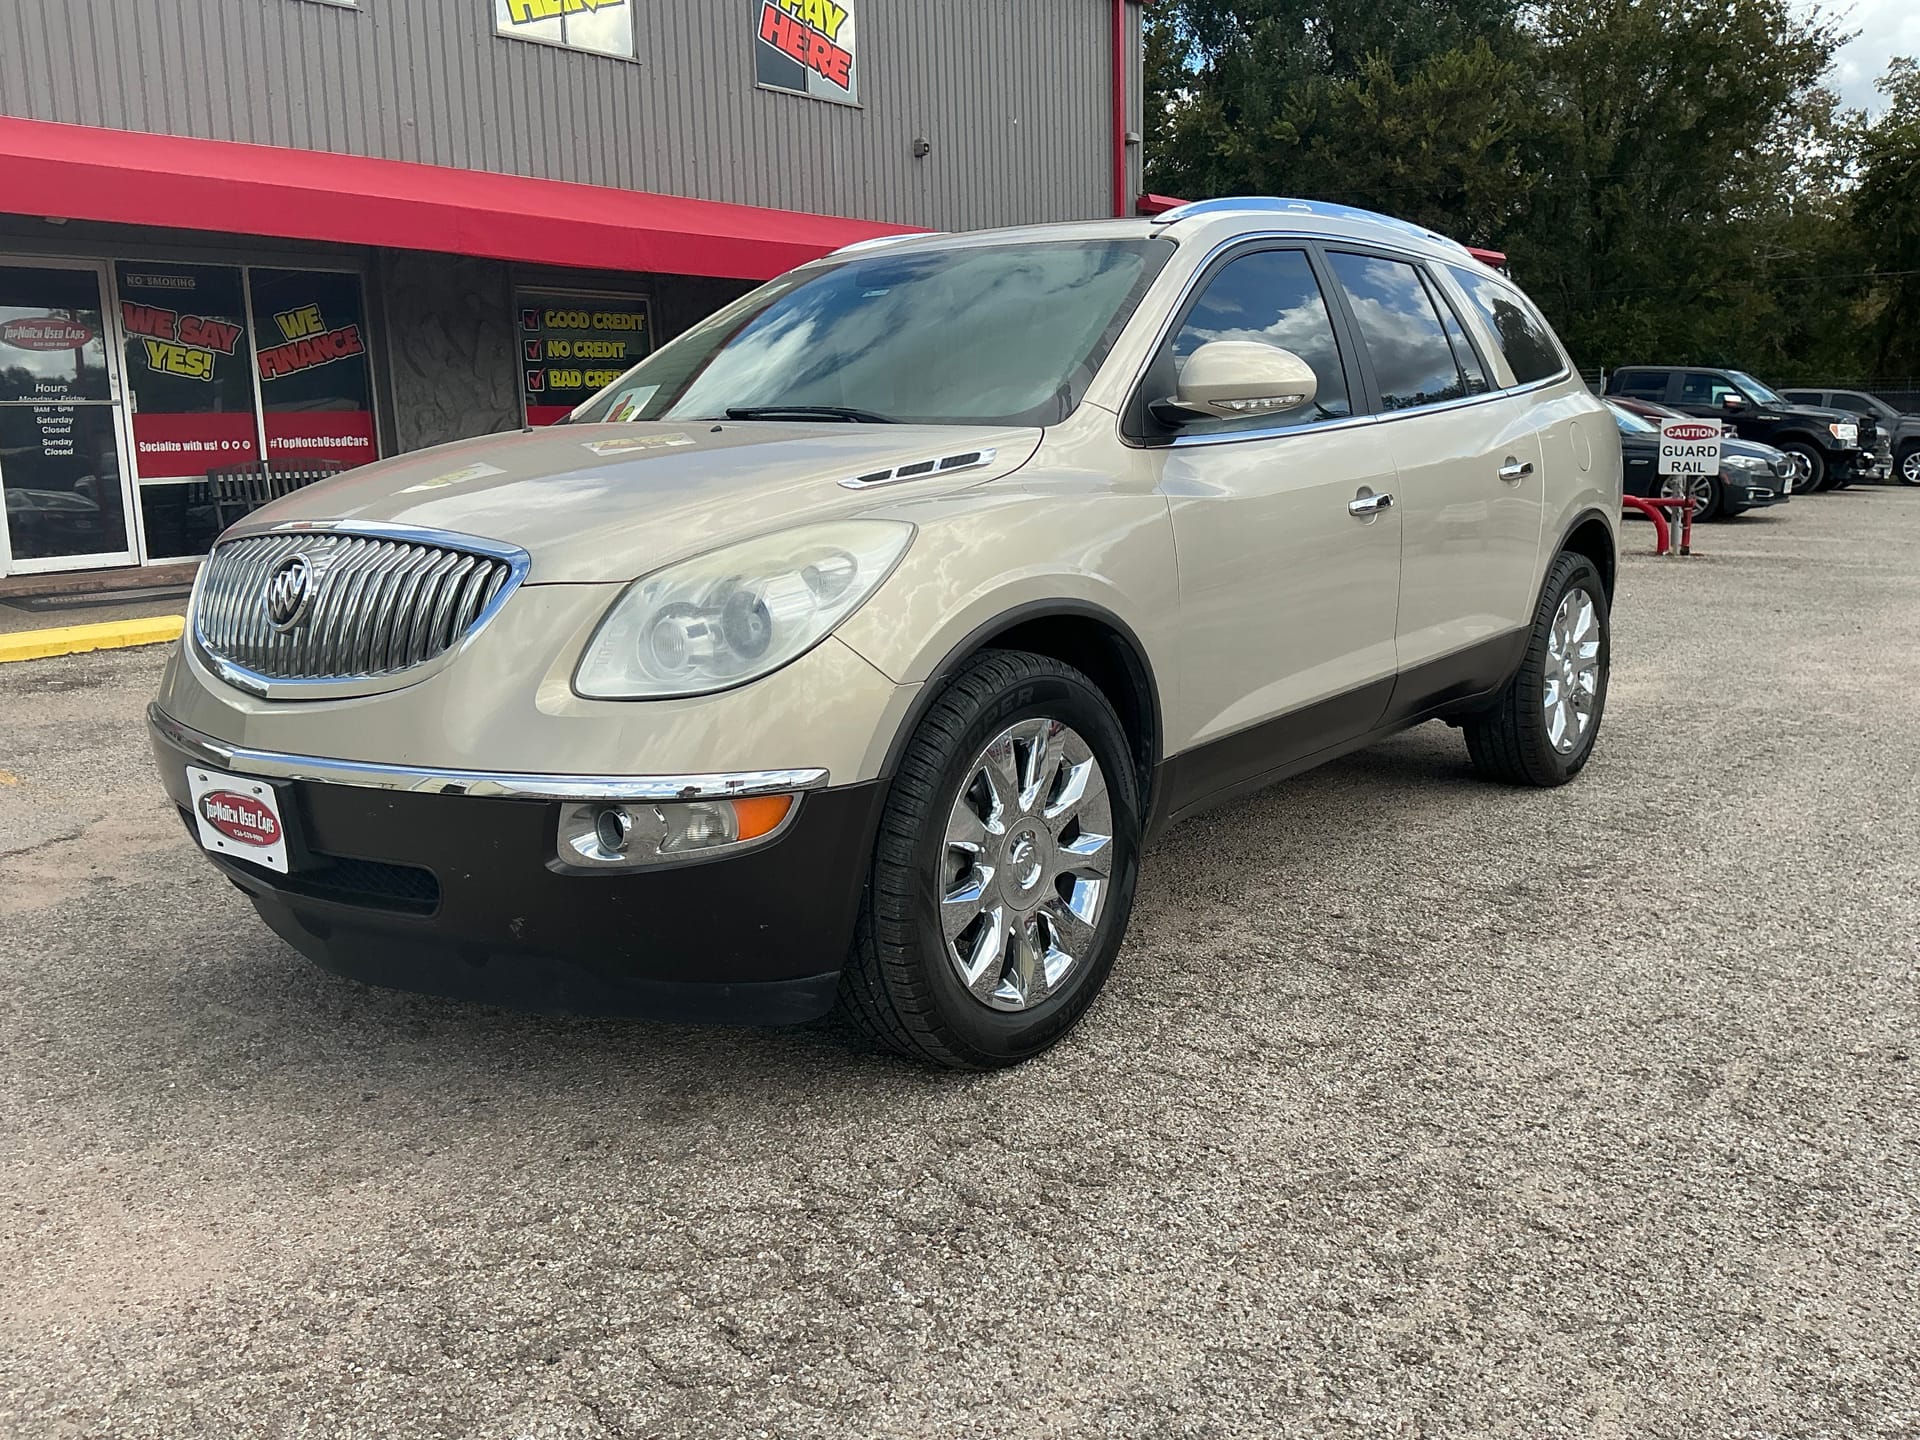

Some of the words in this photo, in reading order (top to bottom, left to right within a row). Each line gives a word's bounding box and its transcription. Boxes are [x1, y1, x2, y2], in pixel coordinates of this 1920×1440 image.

[761, 5, 852, 90] HERE
[126, 275, 143, 285] NO
[147, 277, 196, 288] SMOKING
[276, 305, 324, 339] WE
[544, 309, 590, 329] GOOD
[592, 312, 645, 331] CREDIT
[121, 302, 176, 341] WE
[179, 315, 241, 354] SAY
[257, 325, 364, 379] FINANCE
[547, 340, 571, 358] NO
[573, 341, 626, 358] CREDIT
[145, 340, 213, 378] YES!
[549, 370, 582, 388] BAD
[35, 383, 68, 393] Hours
[36, 416, 74, 425] Saturday
[42, 426, 71, 434] Closed
[1666, 428, 1716, 438] CAUTION
[42, 438, 73, 446] Sunday
[139, 441, 181, 452] Socialize
[182, 440, 202, 451] with
[203, 440, 218, 450] us!
[270, 436, 369, 449] #TopNotchUsedCars
[44, 448, 74, 456] Closed
[1662, 445, 1718, 457] GUARD
[1671, 461, 1706, 473] RAIL
